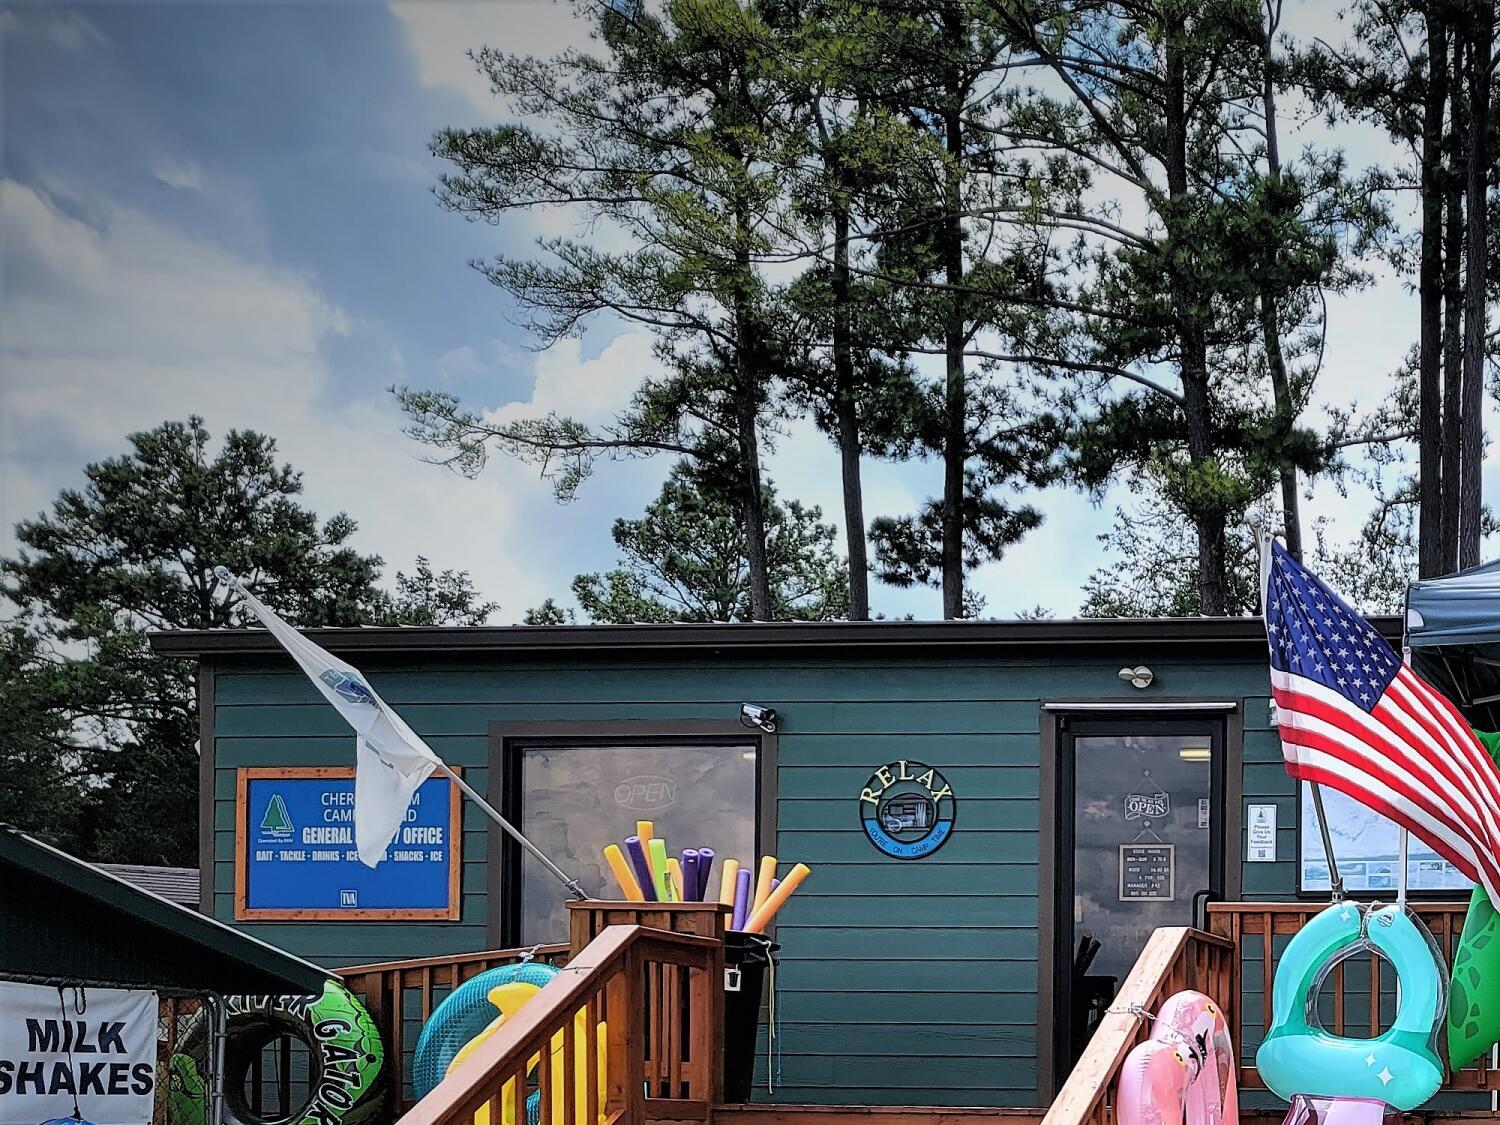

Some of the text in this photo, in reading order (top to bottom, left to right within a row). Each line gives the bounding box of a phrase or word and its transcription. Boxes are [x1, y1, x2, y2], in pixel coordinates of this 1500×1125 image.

[860, 760, 953, 806] RELAX
[614, 782, 677, 804] OPEN
[1130, 801, 1165, 815] OPEN
[302, 827, 353, 845] GENERAL
[403, 827, 443, 845] OFFICE
[256, 850, 274, 862] BAIT
[279, 850, 306, 862] TACKLE
[312, 850, 341, 862] DRINKS
[346, 850, 359, 862] ICE
[393, 850, 424, 862] SNACKS
[430, 850, 443, 862] ICE
[893, 845, 903, 855] ON
[342, 892, 356, 905] TVA
[25, 1018, 128, 1054] MILK
[0, 1060, 154, 1096] SHAKES
